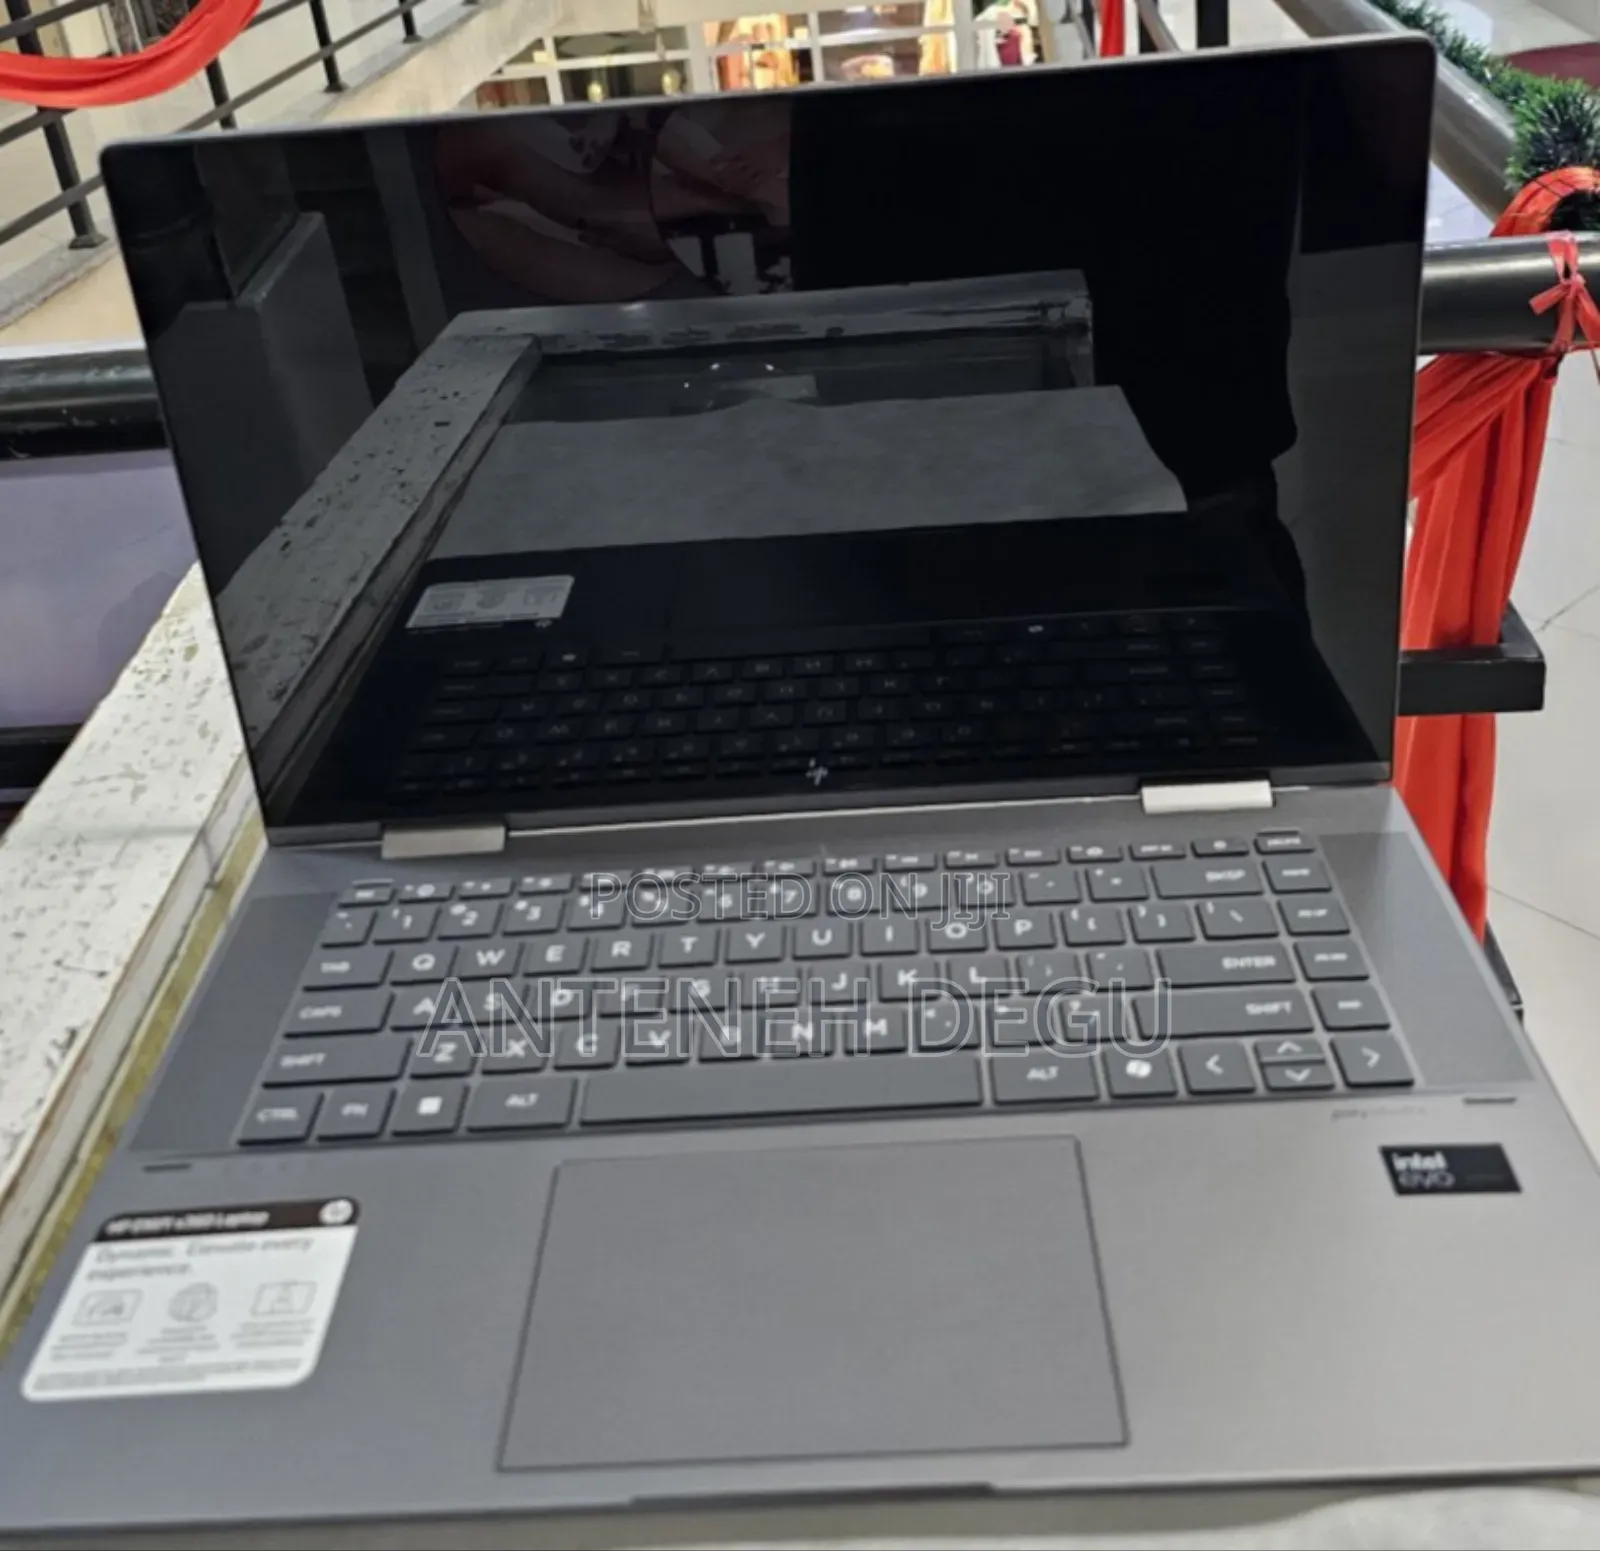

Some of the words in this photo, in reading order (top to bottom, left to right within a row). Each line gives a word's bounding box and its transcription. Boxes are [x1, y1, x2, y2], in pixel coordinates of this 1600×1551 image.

[412, 953, 436, 971] Q
[476, 949, 505, 967] W
[545, 945, 565, 962] E
[611, 940, 632, 957] R
[681, 936, 698, 952] T
[746, 932, 766, 949] Y
[812, 928, 832, 945] U
[1014, 919, 1033, 936] P
[1221, 955, 1276, 969] ENTER
[831, 972, 847, 990] J
[897, 968, 918, 985] K
[968, 966, 987, 984] L
[433, 1041, 457, 1062] Z
[505, 1038, 528, 1058] X
[1245, 1001, 1292, 1015] SHIFT
[504, 1092, 539, 1107] ALT
[1026, 1066, 1059, 1081] ALT
[1390, 1151, 1448, 1171] intel
